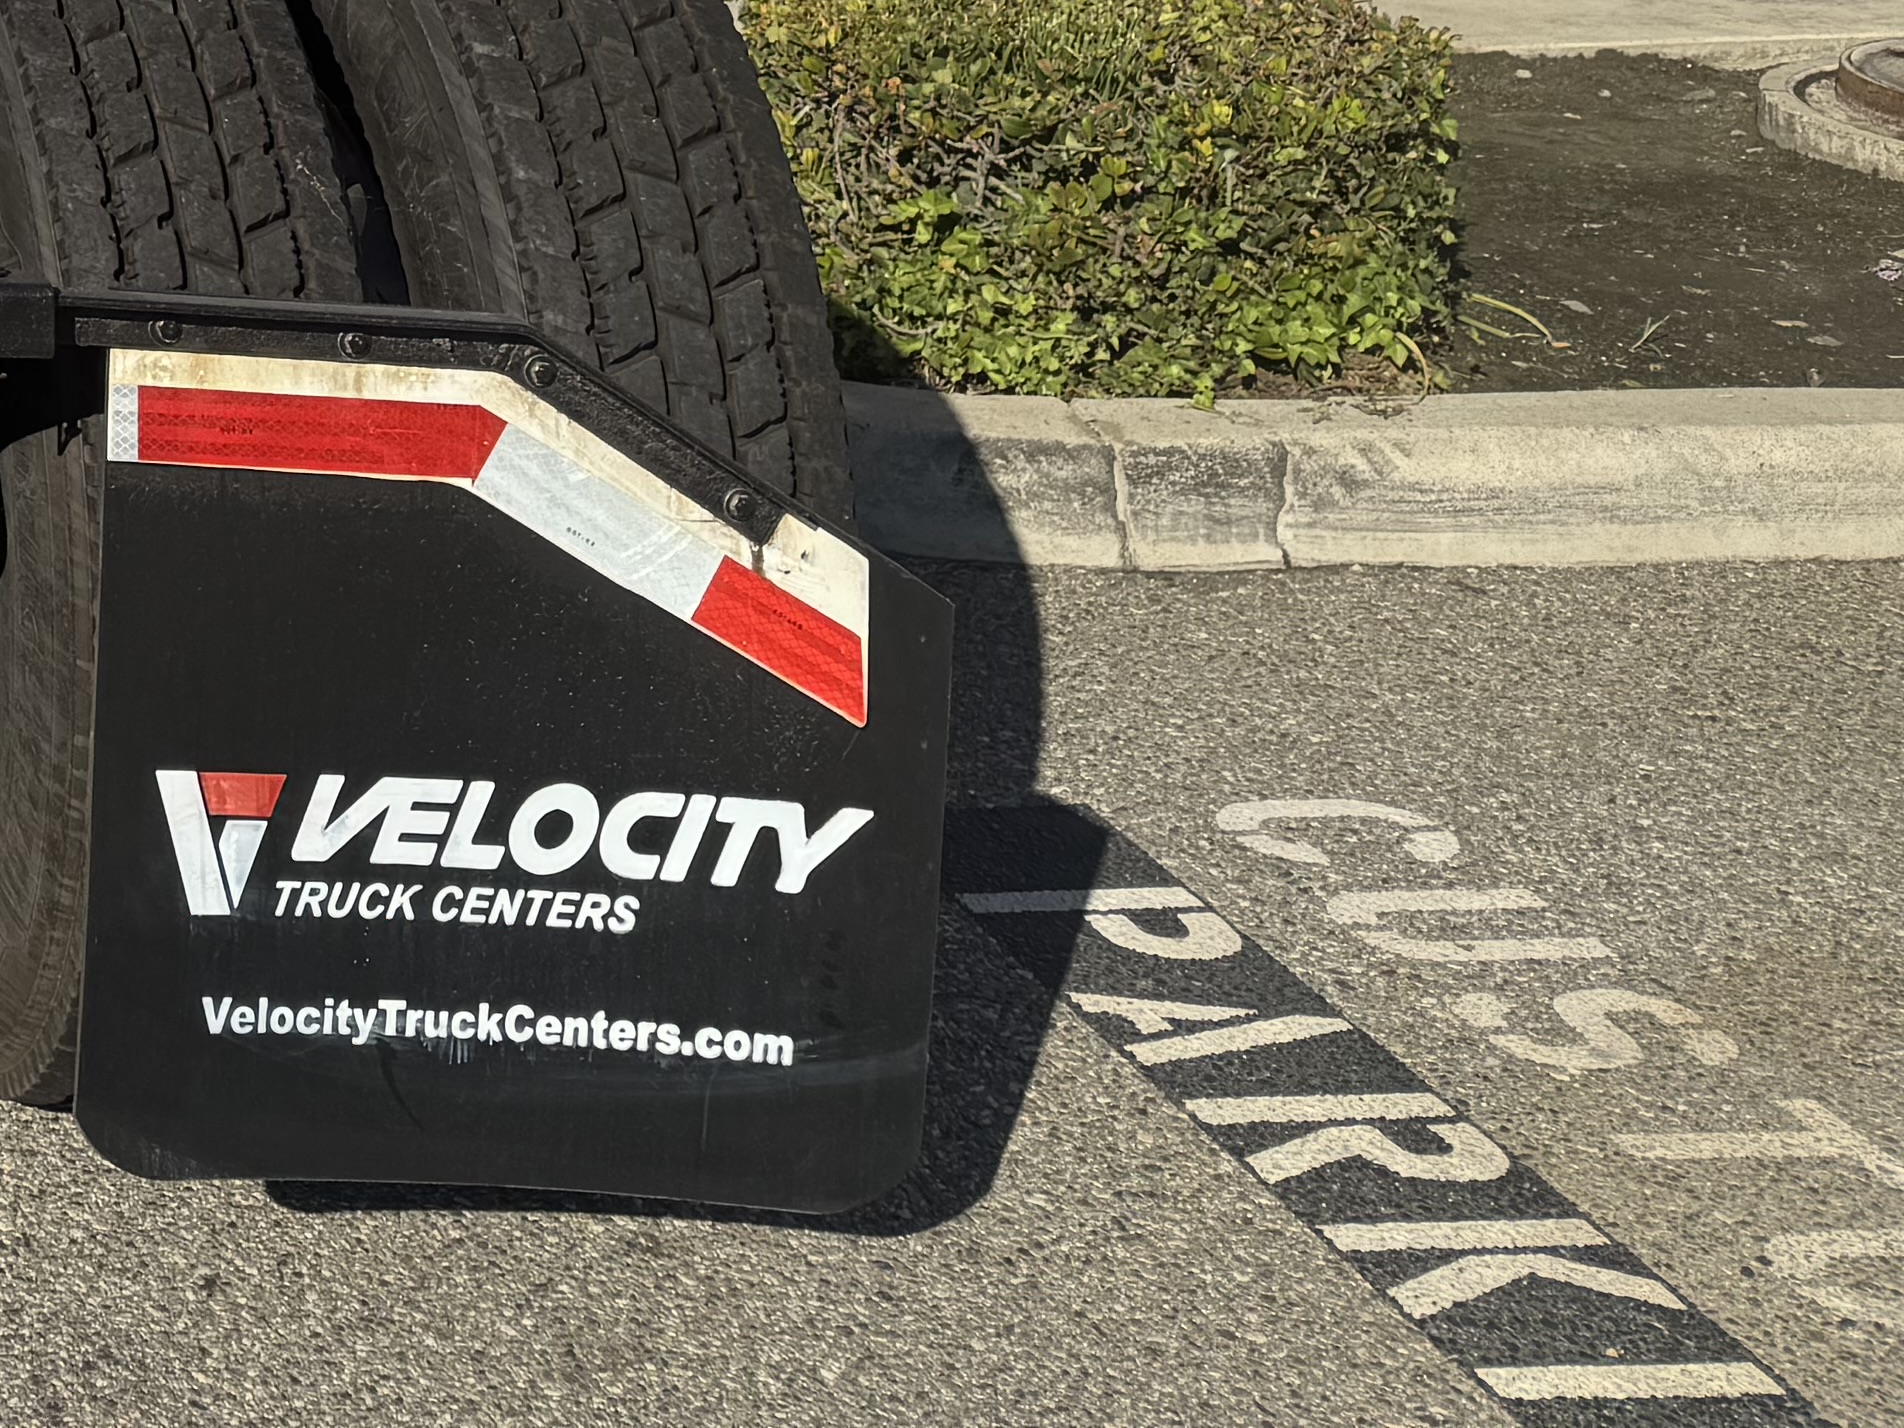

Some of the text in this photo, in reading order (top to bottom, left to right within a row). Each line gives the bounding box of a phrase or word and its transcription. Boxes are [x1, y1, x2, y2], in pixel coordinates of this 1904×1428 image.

[292, 774, 875, 894] VELOCITY
[274, 880, 640, 934] TRUCK CENTERS
[203, 996, 794, 1066] VelocityTruckCenters.com
